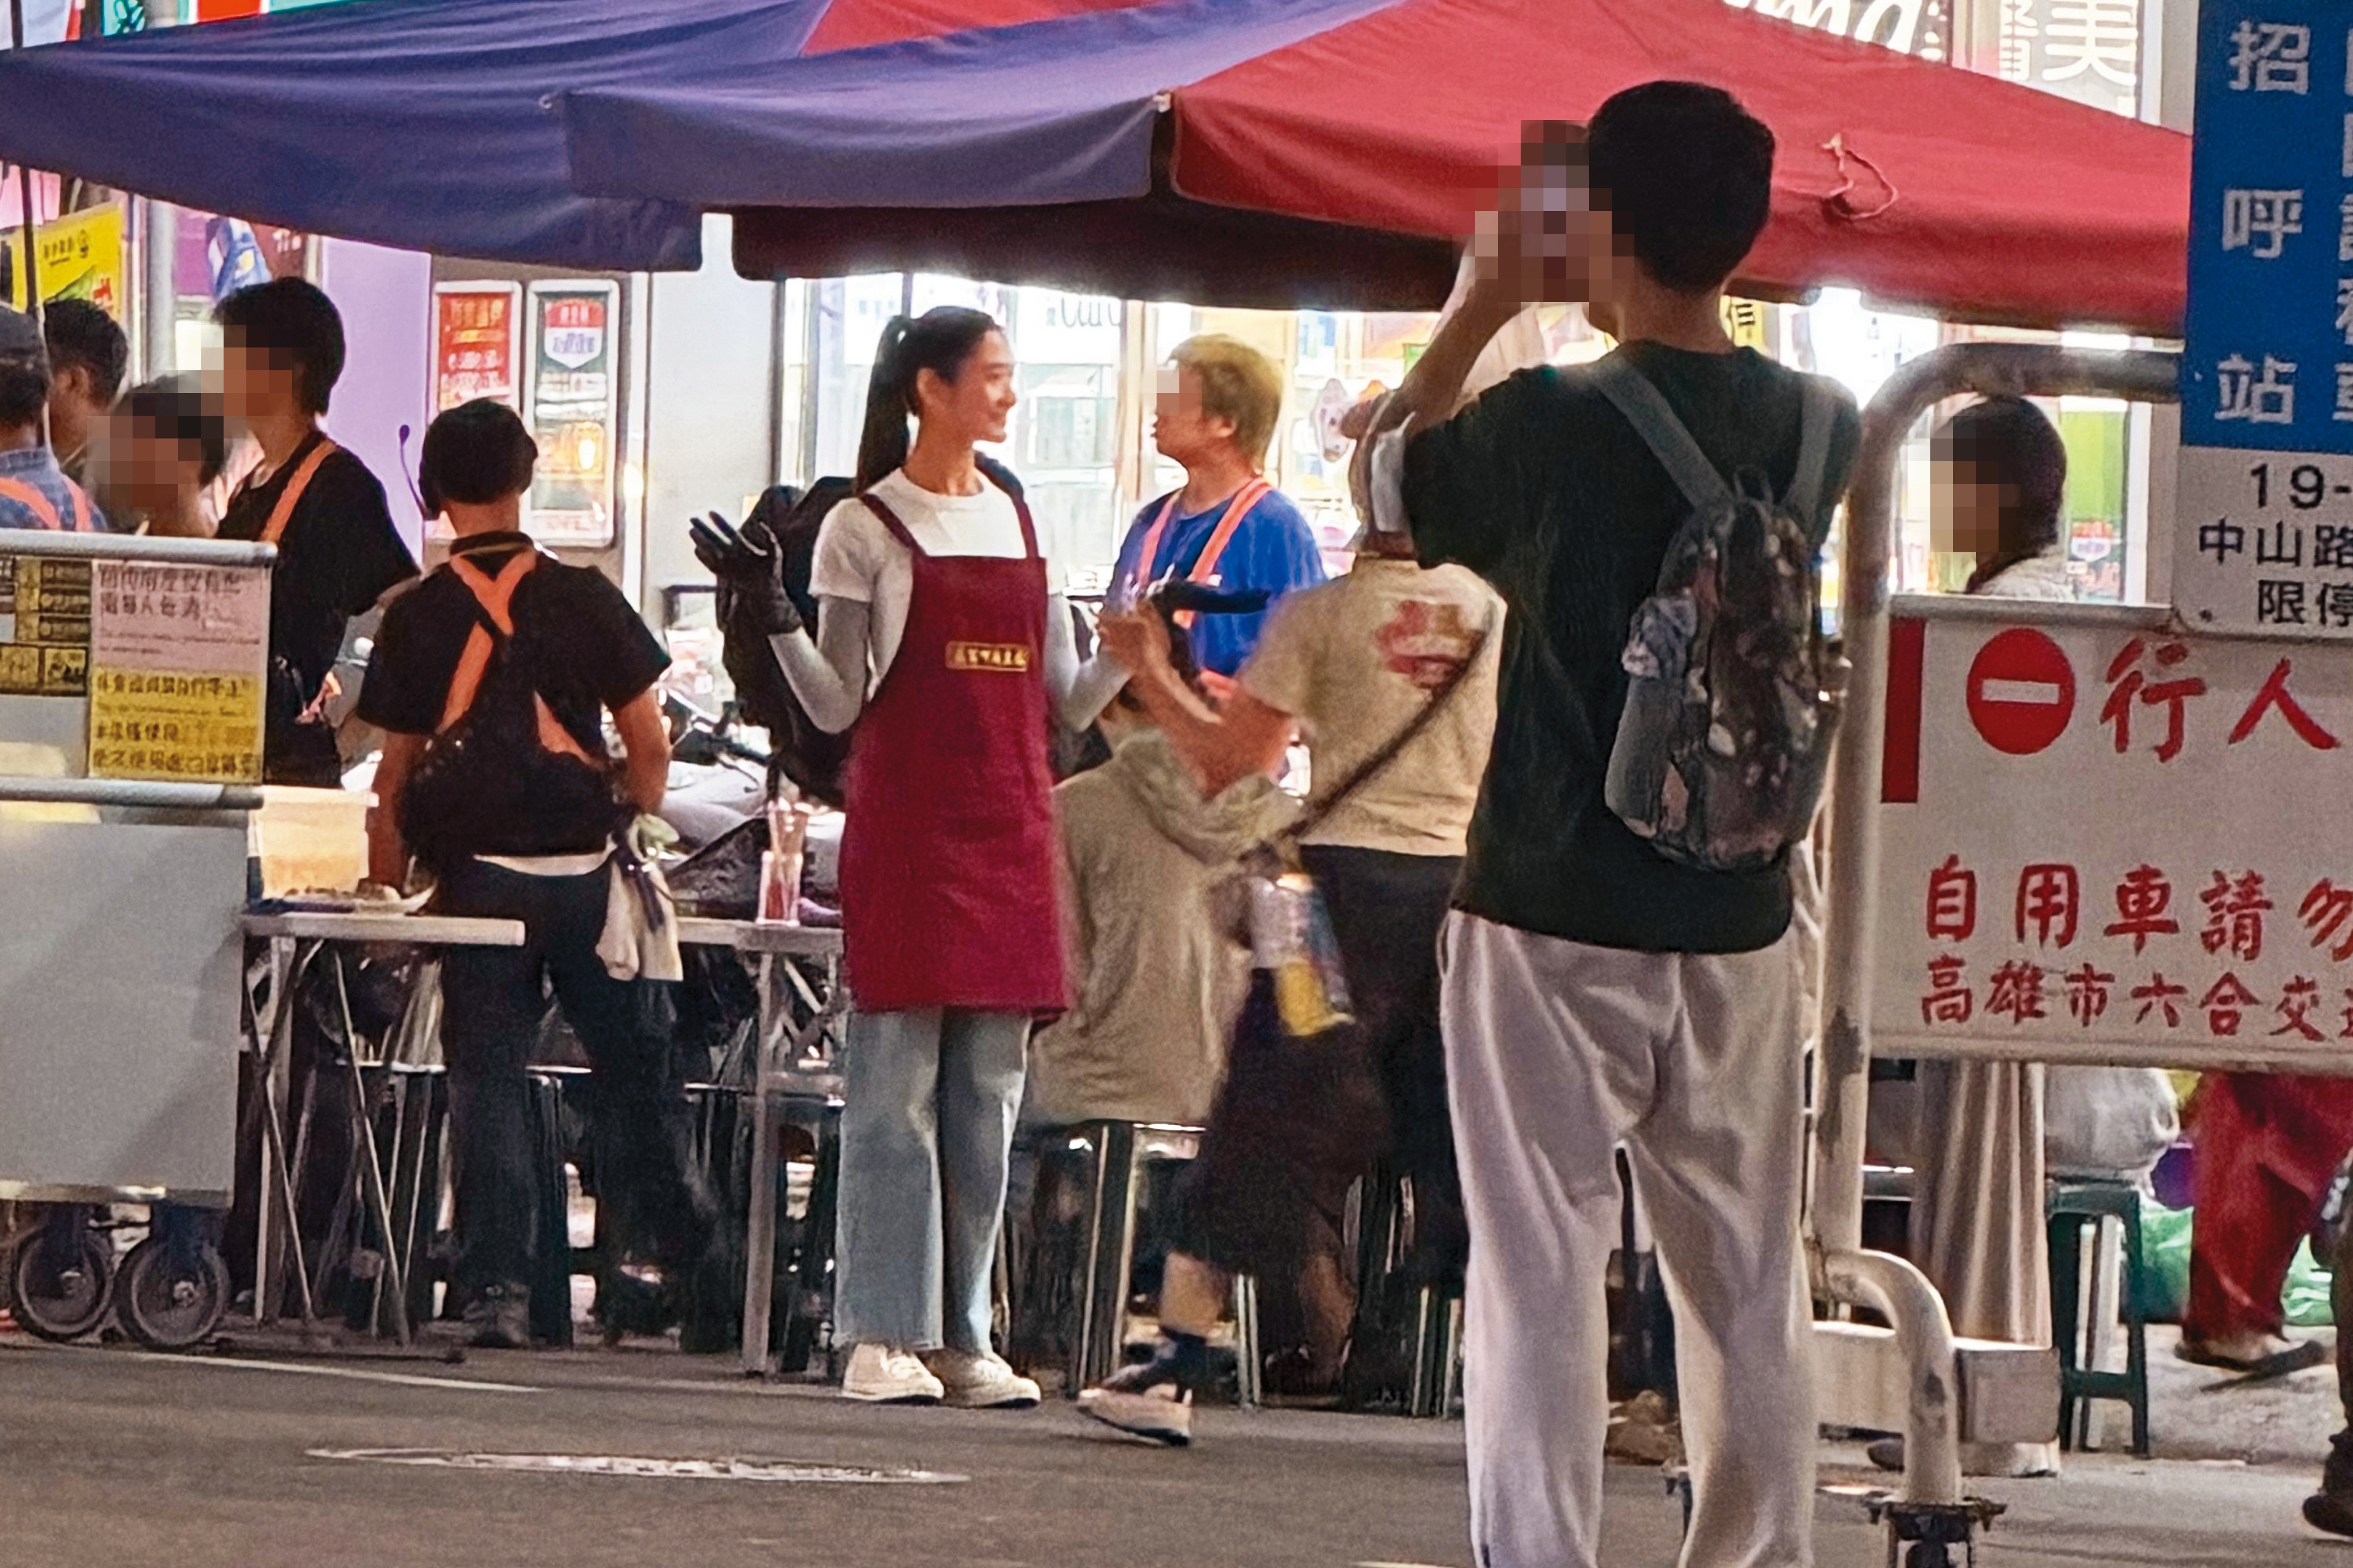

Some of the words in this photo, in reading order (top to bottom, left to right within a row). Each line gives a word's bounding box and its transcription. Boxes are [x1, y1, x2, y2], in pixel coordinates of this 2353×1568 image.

[2214, 20, 2311, 424] 招呼站
[2199, 515, 2353, 568] 中山路
[2257, 580, 2353, 627] 限停
[2099, 638, 2340, 763] 行人
[1926, 854, 2353, 962] 自用車請勿
[1921, 952, 2353, 1042] 高雄市六合交
